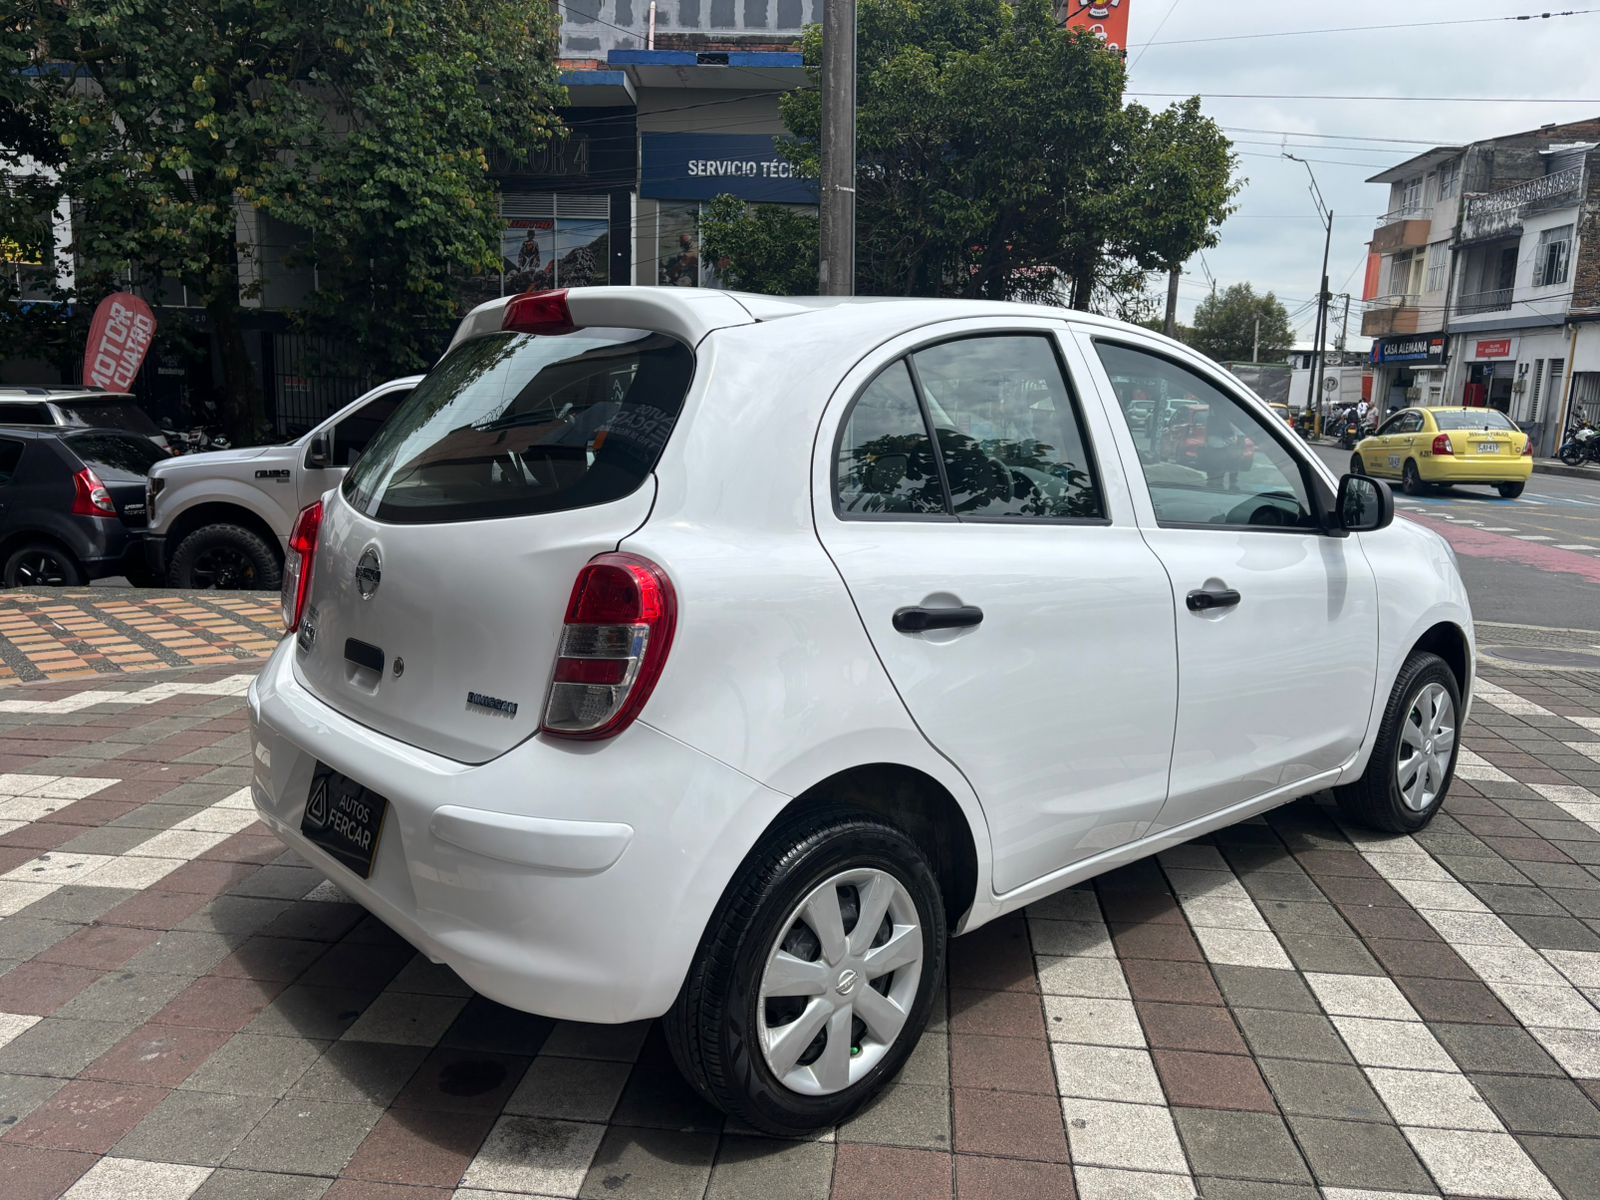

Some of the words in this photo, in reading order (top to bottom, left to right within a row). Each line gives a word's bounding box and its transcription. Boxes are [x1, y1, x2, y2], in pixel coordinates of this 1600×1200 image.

[687, 159, 757, 177] SERVICIO
[91, 301, 134, 388] MOTOR
[113, 313, 153, 389] CUATRO
[1384, 343, 1398, 355] CASA
[1398, 340, 1428, 354] ALEMANA
[340, 794, 370, 823] AUTOS
[328, 808, 371, 850] FERCAR
